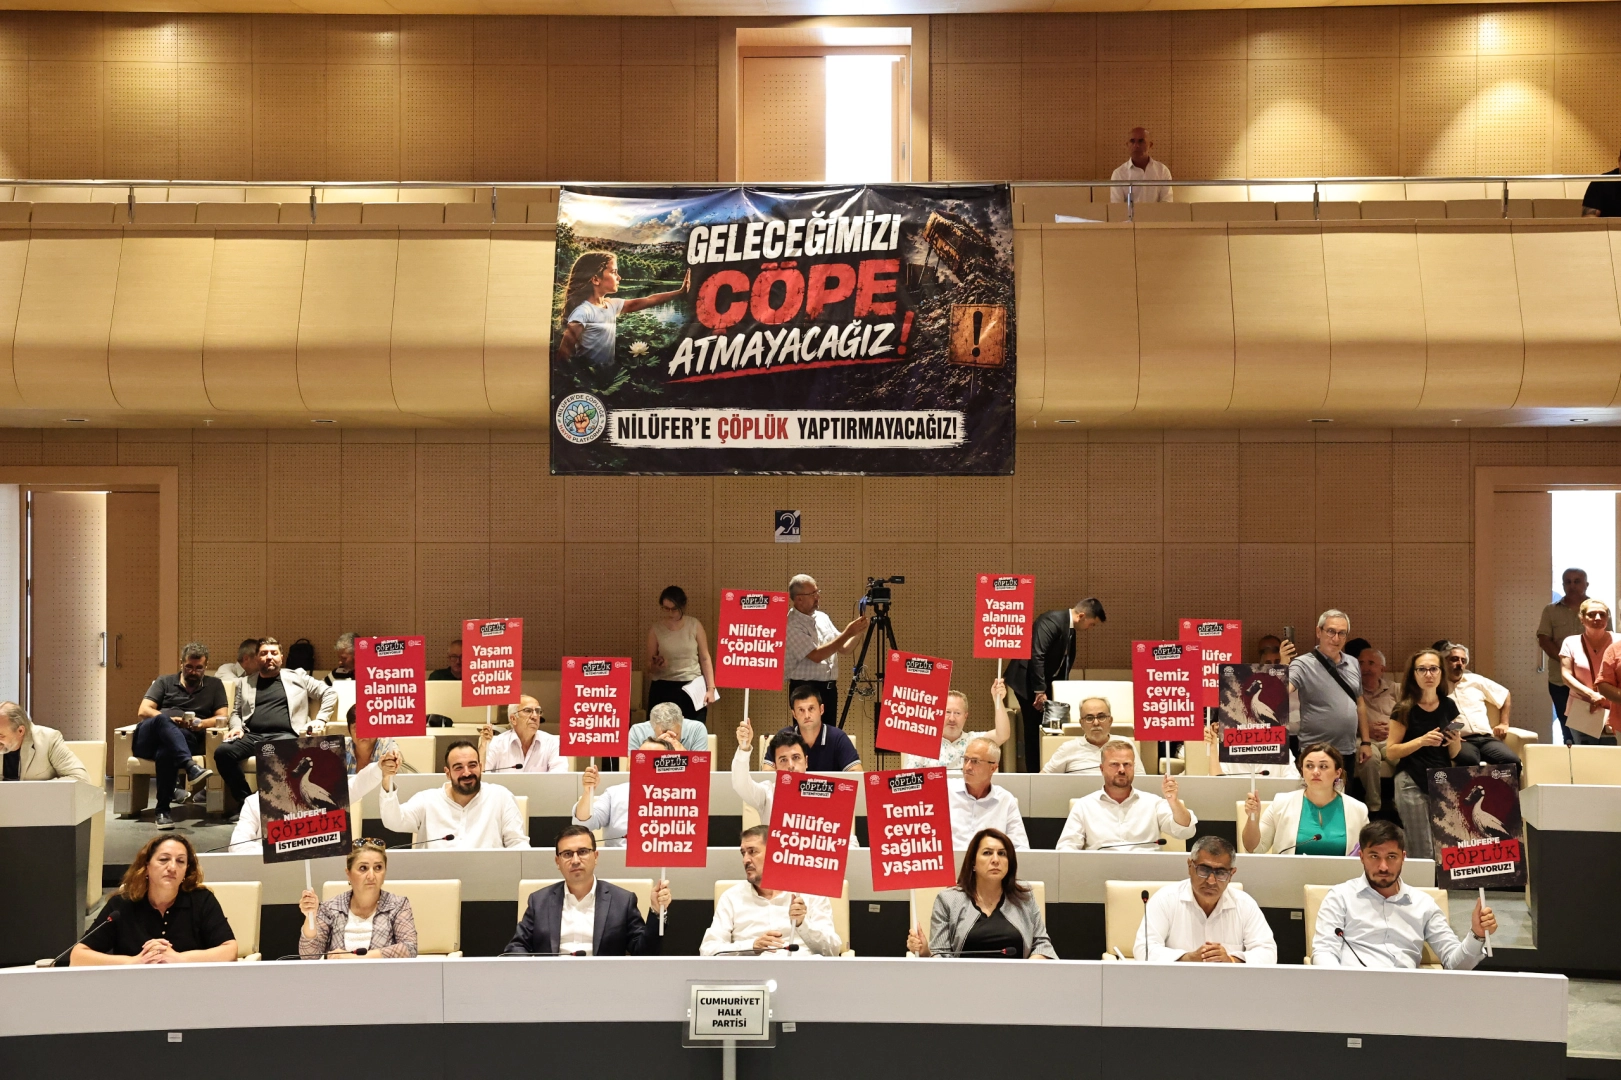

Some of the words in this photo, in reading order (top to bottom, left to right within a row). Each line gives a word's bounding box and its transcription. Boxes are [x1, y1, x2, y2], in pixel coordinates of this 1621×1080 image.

[696, 259, 900, 334] ÇÖPE
[572, 425, 603, 442] PLATFORMU
[618, 413, 711, 440] NİLÜFER'E
[718, 414, 789, 443] ÇÖPLÜK
[798, 414, 957, 440] YAPTIRMAYACAĞIZ!
[985, 599, 1024, 611] Yaşam
[982, 612, 1025, 623] alanına
[729, 624, 776, 638] Nilüfer
[983, 624, 1023, 638] çöplük
[720, 638, 783, 653] “çöplük”
[985, 638, 1021, 649] olmaz
[472, 645, 512, 658] Yaşam
[1202, 649, 1232, 661] lüfer
[470, 659, 514, 670] alanına
[723, 653, 778, 668] olmasın
[367, 666, 414, 681] Yaşam
[471, 670, 512, 684] çöplük
[1146, 669, 1189, 681] Temiz
[364, 682, 417, 695] alanına
[473, 684, 510, 696] olmaz
[575, 685, 617, 698] Temiz
[893, 685, 938, 705] Nilüfer
[1146, 686, 1190, 699] çevre,
[366, 696, 415, 712] çöplük
[574, 702, 617, 714] çevre,
[884, 699, 943, 721] “çöplük”
[1143, 699, 1194, 714] sağlıklı
[369, 712, 413, 726] olmaz
[569, 715, 620, 729] sağlıklı
[885, 716, 937, 736] olmasın
[1143, 715, 1194, 730] yaşam!
[1237, 723, 1271, 731] NİLÜFER'E
[569, 731, 619, 745] yaşam!
[1226, 729, 1284, 745] ÇÖPLÜK
[1231, 745, 1278, 753] İSTEMİYORUZ!
[654, 757, 688, 768] ÇÖPLÜK
[800, 781, 834, 793] ÇÖPLÜK
[890, 774, 923, 789] ÇÖPLÜK
[642, 785, 696, 801] Yaşam
[283, 808, 327, 821] NİLÜFER'E
[638, 802, 698, 817] alanına
[883, 801, 934, 819] Temiz
[271, 814, 343, 842] ÇÖPLÜK
[639, 820, 695, 838] çöplük
[782, 813, 840, 834] Nilüfer
[884, 823, 936, 840] çevre,
[279, 834, 338, 850] İSTEMİYORUZ!
[642, 839, 692, 853] olmaz
[771, 829, 847, 852] “çöplük”
[881, 837, 942, 857] sağlıklı
[1457, 837, 1500, 849] NİLÜFER'E
[772, 849, 839, 871] olmasın
[1445, 844, 1517, 868] ÇÖPLÜK
[882, 855, 944, 876] yaşam!
[1453, 863, 1511, 877] İSTEMİYORUZ!
[700, 996, 760, 1005] CUMHURİYET
[712, 1018, 747, 1027] PARTİSİ
